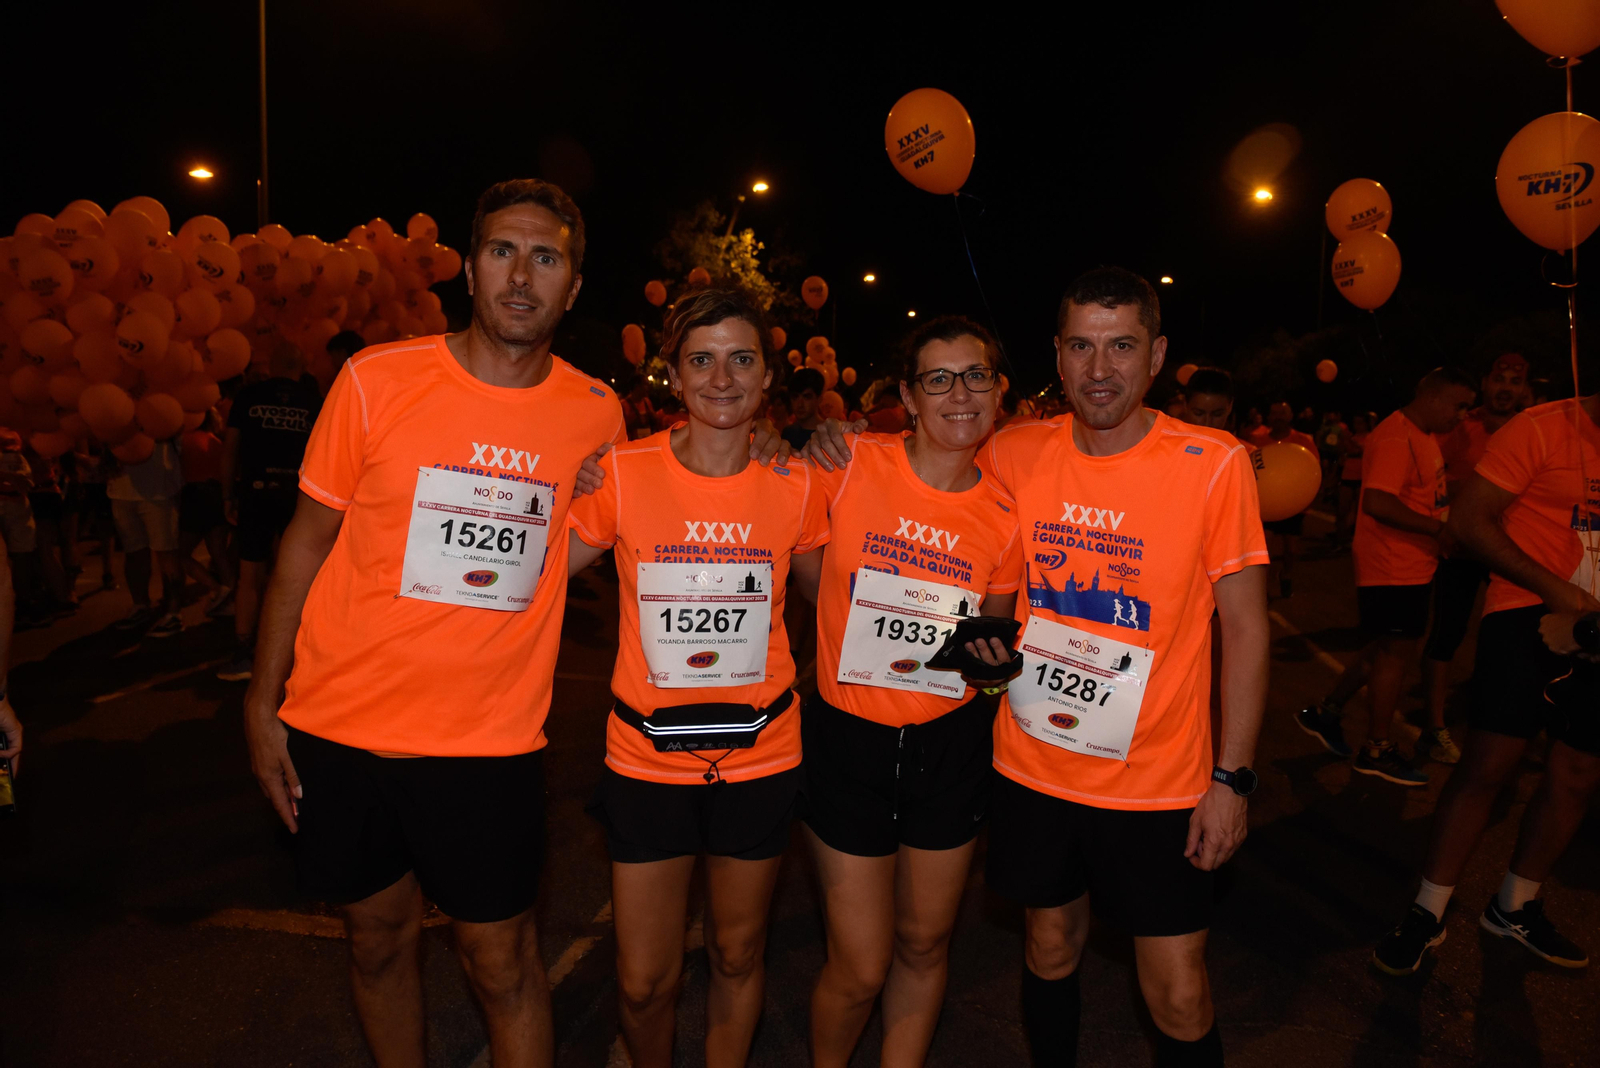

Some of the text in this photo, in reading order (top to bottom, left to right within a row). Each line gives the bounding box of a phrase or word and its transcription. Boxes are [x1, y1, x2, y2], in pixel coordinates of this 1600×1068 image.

[897, 123, 930, 150] XXXV
[1518, 170, 1562, 181] NOCTURNA
[1555, 198, 1592, 211] SEVILLA
[249, 404, 309, 420] #YOSOY
[468, 442, 540, 474] XXXV
[436, 504, 459, 512] CARRERA
[459, 508, 488, 516] NOCTURNA
[498, 513, 529, 522] GUADALQUIVIR
[1060, 501, 1125, 531] XXXV
[440, 519, 527, 555] 15261
[683, 521, 752, 544] XXXV
[894, 516, 960, 552] XXXV
[1034, 521, 1144, 547] CARRERA NOCTURNA
[654, 545, 773, 558] CARRERA NOCTURNA
[865, 532, 973, 571] CARRERA NOCTURNA
[1039, 532, 1143, 561] GUADALQUIVIR
[463, 553, 504, 565] CANDELARIO
[870, 544, 971, 583] GUADALQUIVIR
[660, 608, 747, 633] 15267
[872, 602, 892, 610] CARRERA
[891, 606, 916, 615] NOCTURNA
[924, 612, 956, 622] GUADALQUIVIR
[874, 616, 952, 646] 19331
[1035, 649, 1055, 658] CARRERA
[1054, 655, 1077, 666] NOCTURNA
[730, 670, 760, 679] Cruzcampo
[1036, 663, 1117, 707] 15287
[927, 681, 958, 692] Cruzcampo
[1048, 696, 1088, 713] ANTONIO RIOS
[1086, 742, 1120, 754] Cruzcampo
